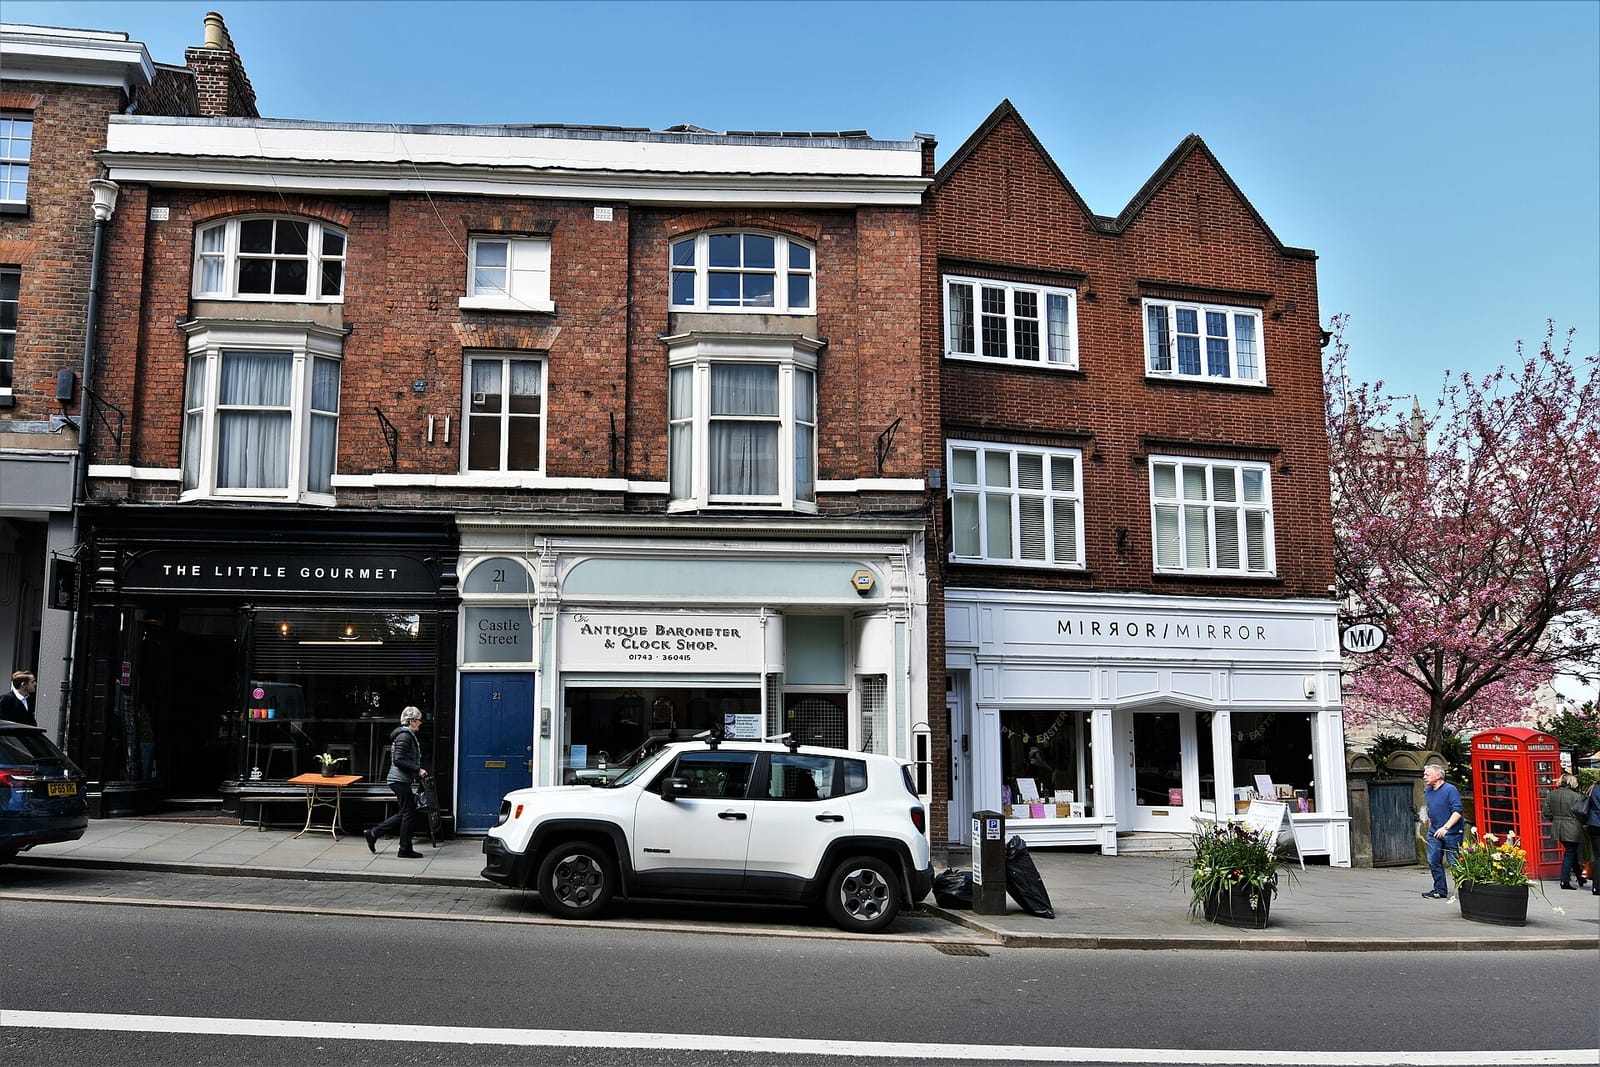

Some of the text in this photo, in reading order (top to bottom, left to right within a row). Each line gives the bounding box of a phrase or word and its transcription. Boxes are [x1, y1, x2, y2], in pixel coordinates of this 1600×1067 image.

[163, 565, 397, 579] THE LITTLE GOURMET
[492, 569, 505, 583] 21
[478, 619, 520, 631] Castle
[581, 623, 741, 638] ANTIQUE BAROMETER
[479, 633, 518, 645] Street
[604, 637, 718, 651] & CLOCK SHOP.
[492, 692, 501, 700] 21
[1036, 711, 1068, 744] EASTER
